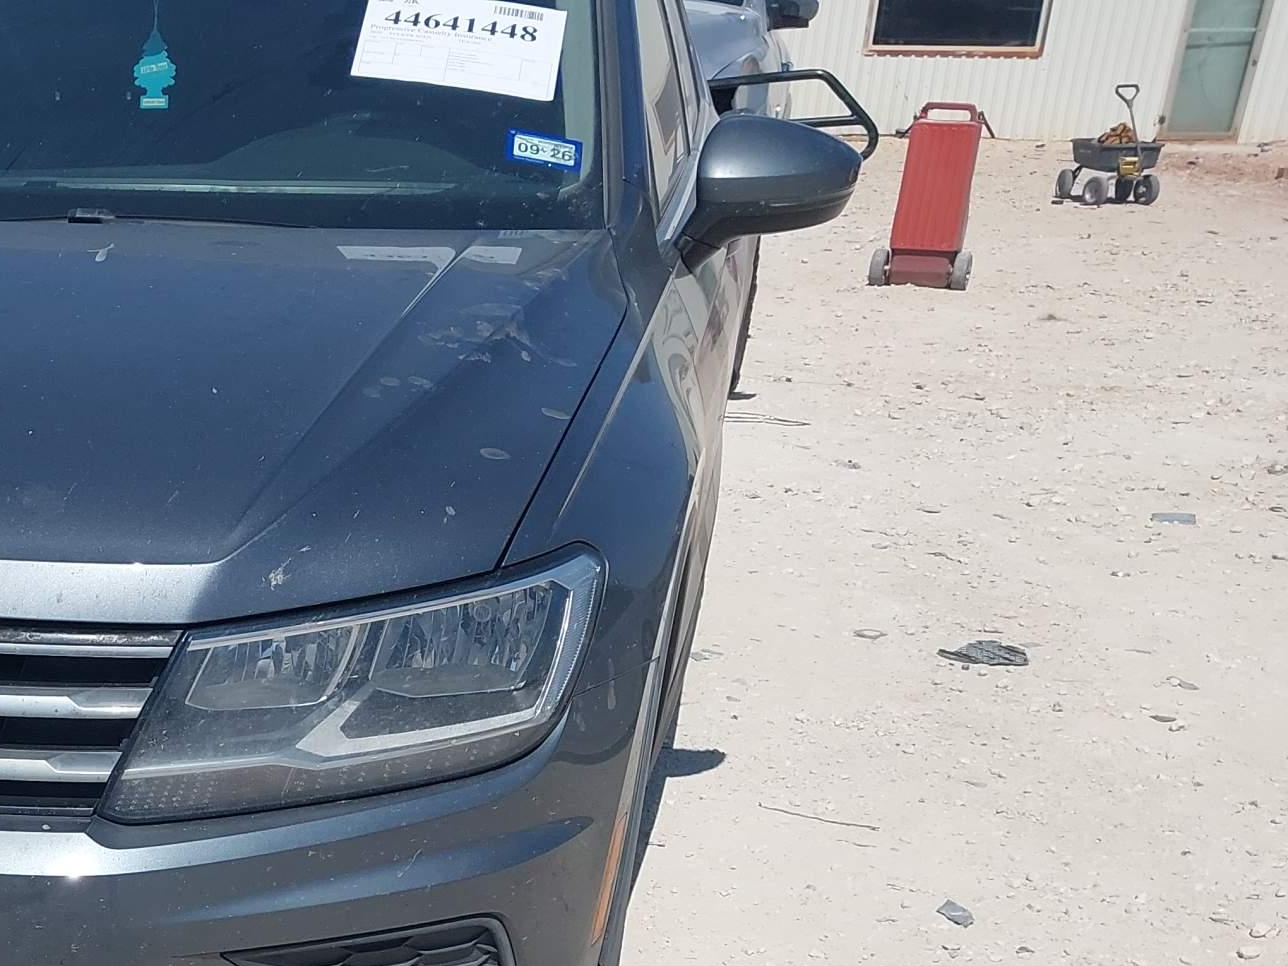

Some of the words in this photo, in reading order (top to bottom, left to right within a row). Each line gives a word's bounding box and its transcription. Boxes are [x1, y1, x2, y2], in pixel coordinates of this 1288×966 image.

[370, 23, 417, 33] Progressive
[384, 10, 539, 42] 44641448
[517, 142, 540, 155] 09
[550, 147, 573, 162] 26
